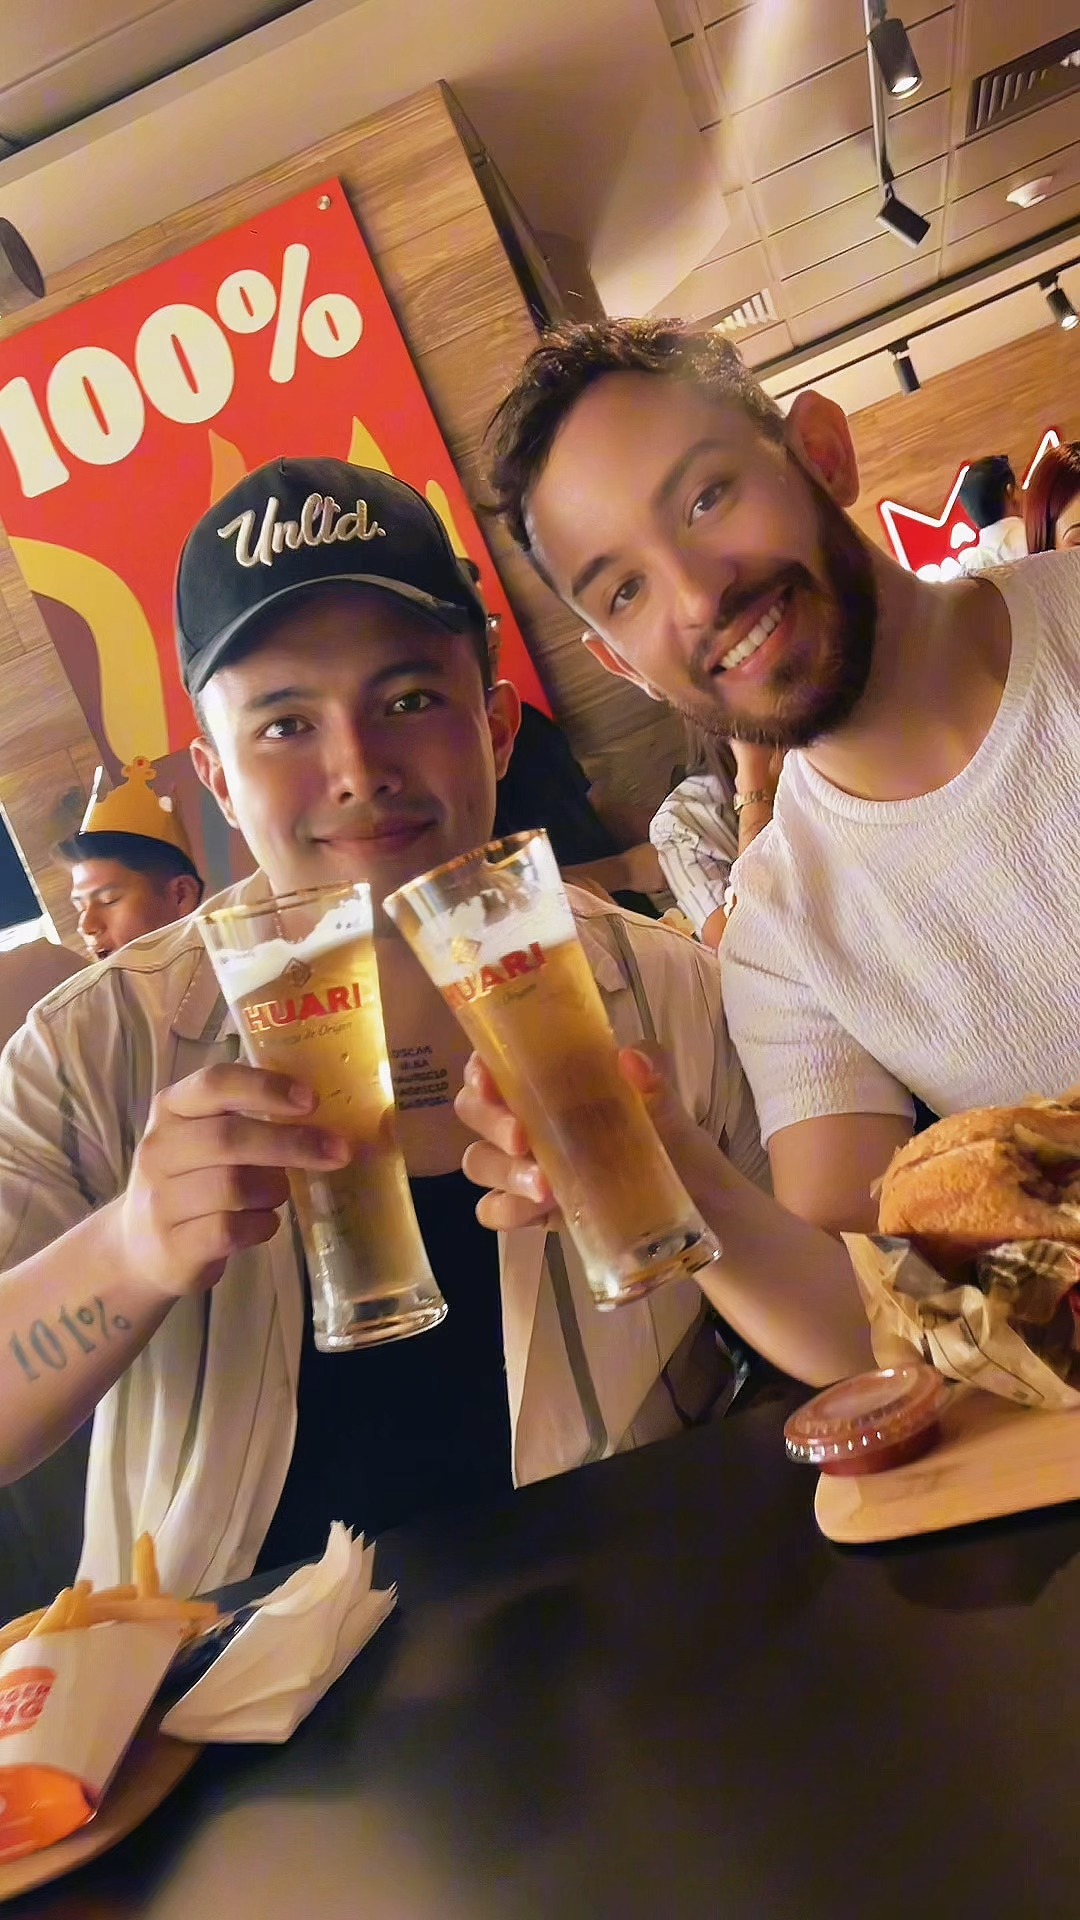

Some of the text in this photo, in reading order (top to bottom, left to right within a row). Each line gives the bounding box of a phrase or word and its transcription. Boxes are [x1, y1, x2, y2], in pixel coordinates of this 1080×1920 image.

[0, 243, 363, 498] 100%
[217, 493, 387, 567] Unltd.
[242, 982, 362, 1034] HUARI
[9, 1295, 132, 1382] 101%
